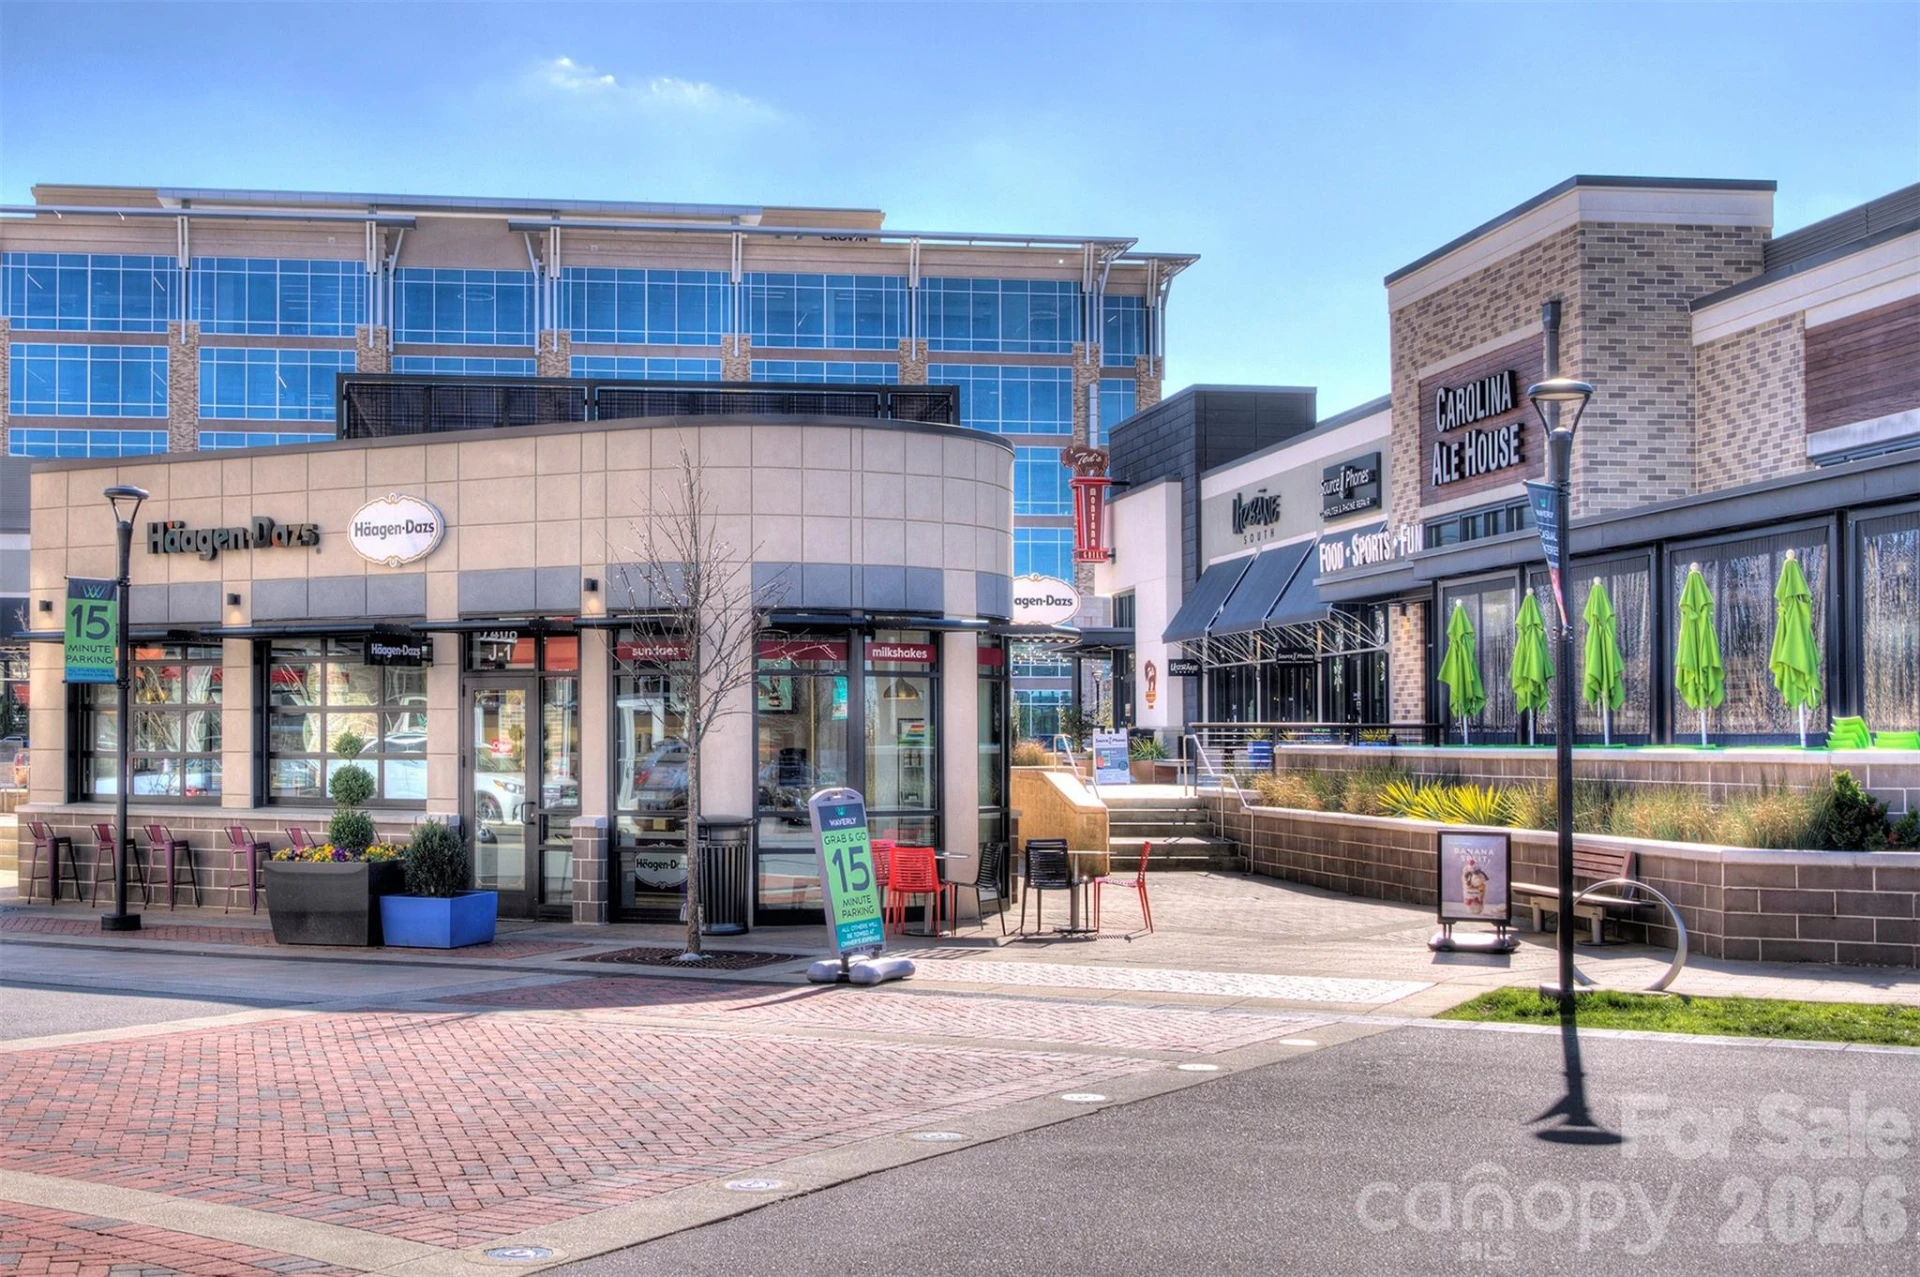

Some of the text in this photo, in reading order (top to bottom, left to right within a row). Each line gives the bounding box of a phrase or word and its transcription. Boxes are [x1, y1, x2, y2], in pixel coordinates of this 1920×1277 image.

[1436, 370, 1514, 433] CAROLINA
[1075, 451, 1102, 466] Ted's
[1432, 424, 1522, 487] ALE HOUSE
[1319, 478, 1340, 497] Source
[1243, 528, 1275, 545] SOUTH
[1319, 523, 1423, 573] FOOD SPORTS FUN
[1014, 595, 1073, 609] agen-Dazs
[71, 604, 111, 640] 15
[68, 644, 112, 653] MINUTE
[488, 644, 511, 661] J-1
[872, 647, 928, 659] milkshakes
[66, 655, 114, 664] PARKING
[829, 817, 857, 826] WAVERLY
[823, 833, 847, 845] GRAB
[855, 831, 867, 842] GO
[636, 858, 680, 871] Häagen-D
[832, 845, 871, 893] 15
[842, 894, 872, 907] MINUTE
[841, 905, 875, 919] PARKING
